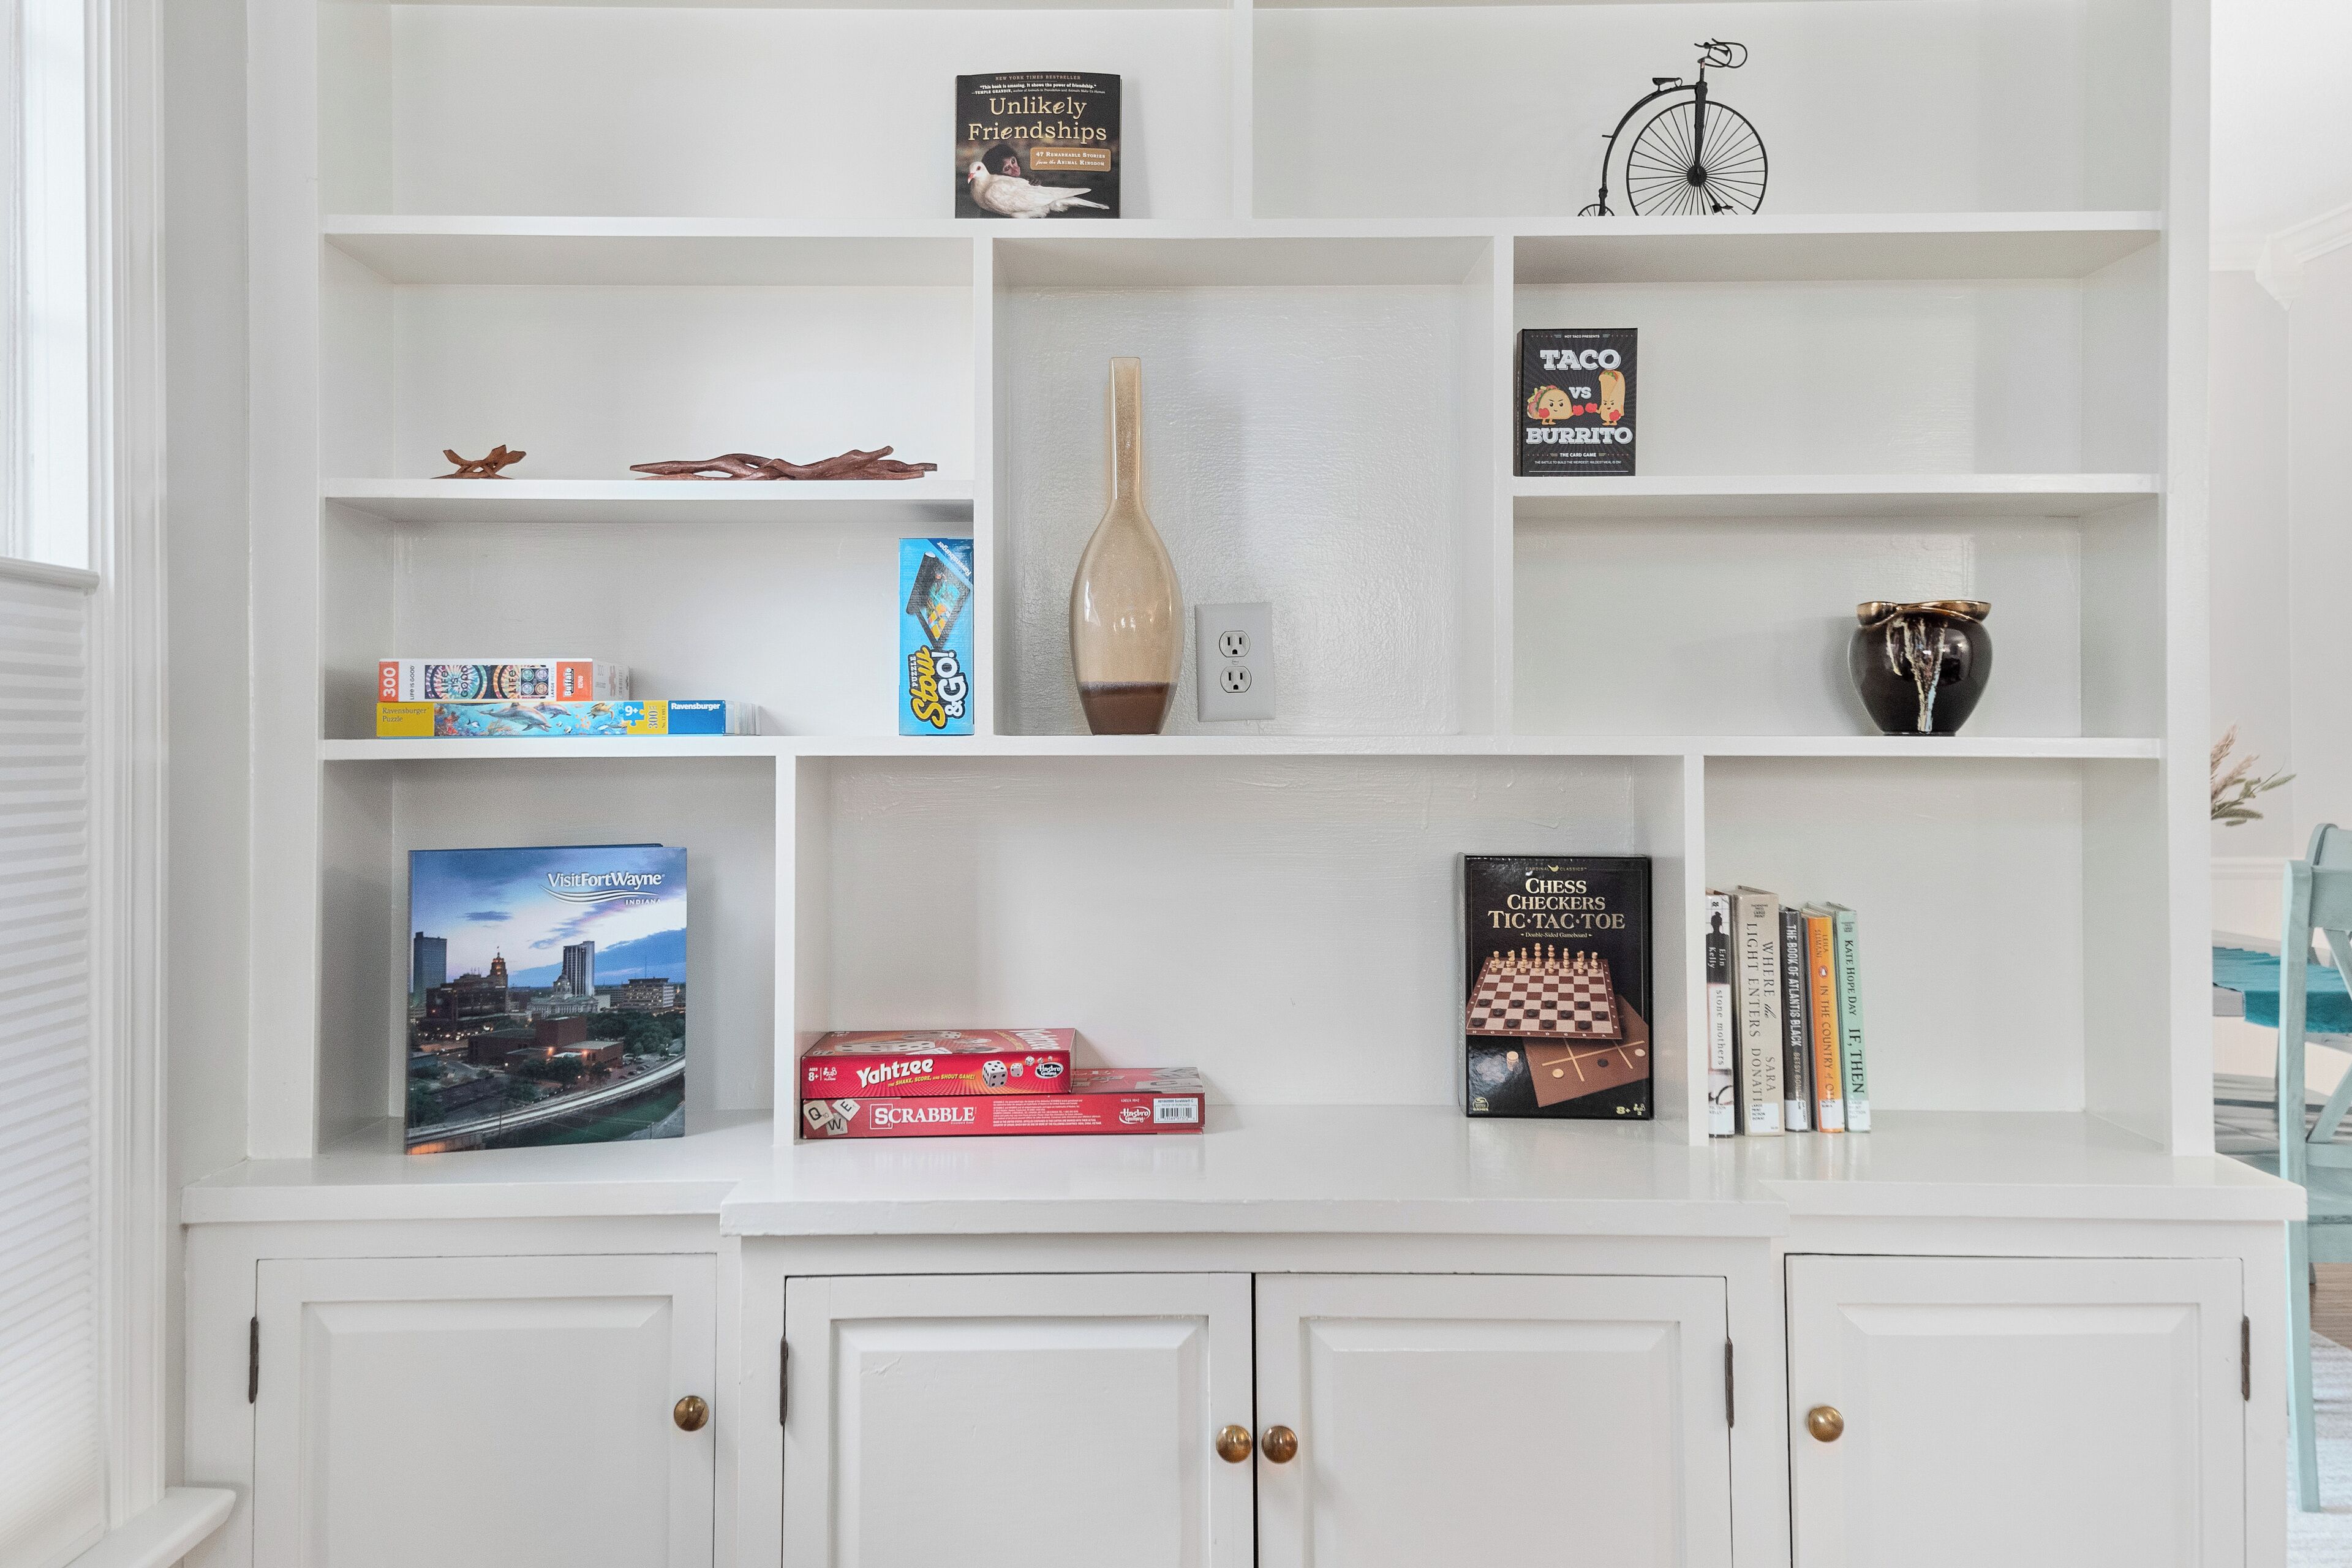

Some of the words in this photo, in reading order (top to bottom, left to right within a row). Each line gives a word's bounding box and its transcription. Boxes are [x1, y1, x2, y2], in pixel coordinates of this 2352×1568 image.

[989, 96, 1087, 119] Unlikely
[968, 121, 1107, 145] Friendships
[1540, 349, 1621, 371] TACO
[1569, 386, 1592, 399] VS
[1526, 427, 1633, 445] BURRITO
[937, 541, 971, 576] Ravensburger
[383, 667, 396, 698] 300
[451, 677, 458, 687] IS
[564, 667, 572, 697] Buffalo
[912, 646, 946, 728] Stow
[625, 705, 639, 716] 9+
[671, 703, 721, 711] Ravensburger
[648, 710, 658, 729] 300
[1525, 878, 1587, 894] CHESS
[1507, 894, 1606, 910] CHECKERS
[1786, 925, 1797, 941] THE
[1708, 947, 1717, 968] Kelly
[1746, 922, 1758, 975] LIGHT
[1787, 942, 1799, 965] BOOK
[1845, 940, 1854, 965] KATE
[1762, 941, 1776, 997] WHERE
[1789, 966, 1799, 977] OF
[1820, 985, 1829, 995] IN
[1846, 967, 1856, 993] HOPE
[1789, 979, 1801, 1017] ATLANTIS
[1848, 996, 1858, 1016] DAY
[1748, 979, 1760, 1038] ENTERS
[1763, 1004, 1776, 1019] the
[1820, 1000, 1830, 1018] THE
[1790, 1019, 1802, 1046] BLACK
[1848, 1028, 1861, 1047] IF,
[1821, 1022, 1833, 1069] COUNTRY
[1036, 1063, 1062, 1072] Hasbro
[1793, 1052, 1801, 1072] BETSY
[1850, 1050, 1864, 1094] THEN
[809, 1072, 819, 1081] 8+
[856, 1058, 934, 1088] Yahtzee
[895, 1078, 913, 1087] SHAKE,
[1765, 1057, 1776, 1092] SARA
[875, 1107, 975, 1125] SCRABBLE
[1120, 1108, 1149, 1118] Hasbro
[1616, 1106, 1631, 1115] 8+
